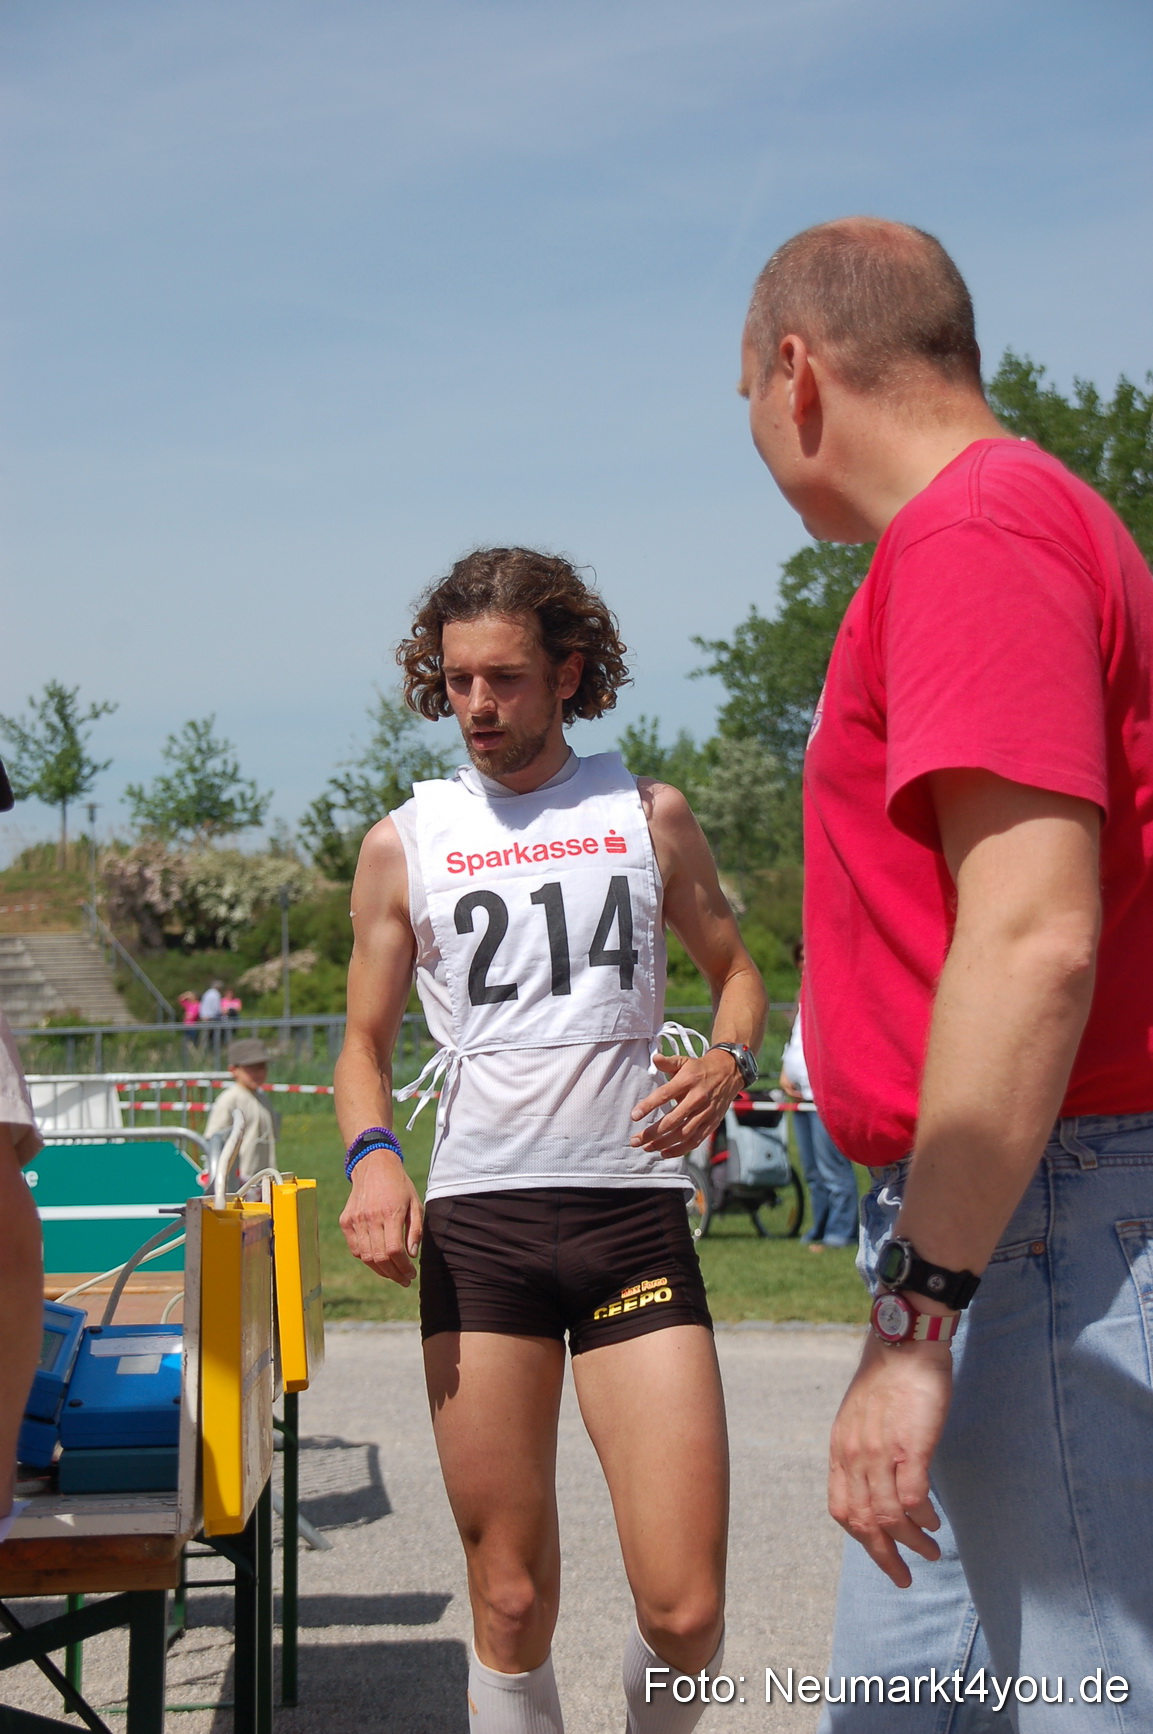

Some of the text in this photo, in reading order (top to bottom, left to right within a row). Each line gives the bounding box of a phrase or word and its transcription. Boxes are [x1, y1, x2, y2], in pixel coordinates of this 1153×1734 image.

[446, 836, 600, 877] Sparkasse
[453, 875, 639, 1007] 214
[640, 1276, 668, 1292] Force
[593, 1286, 673, 1321] CEEPO
